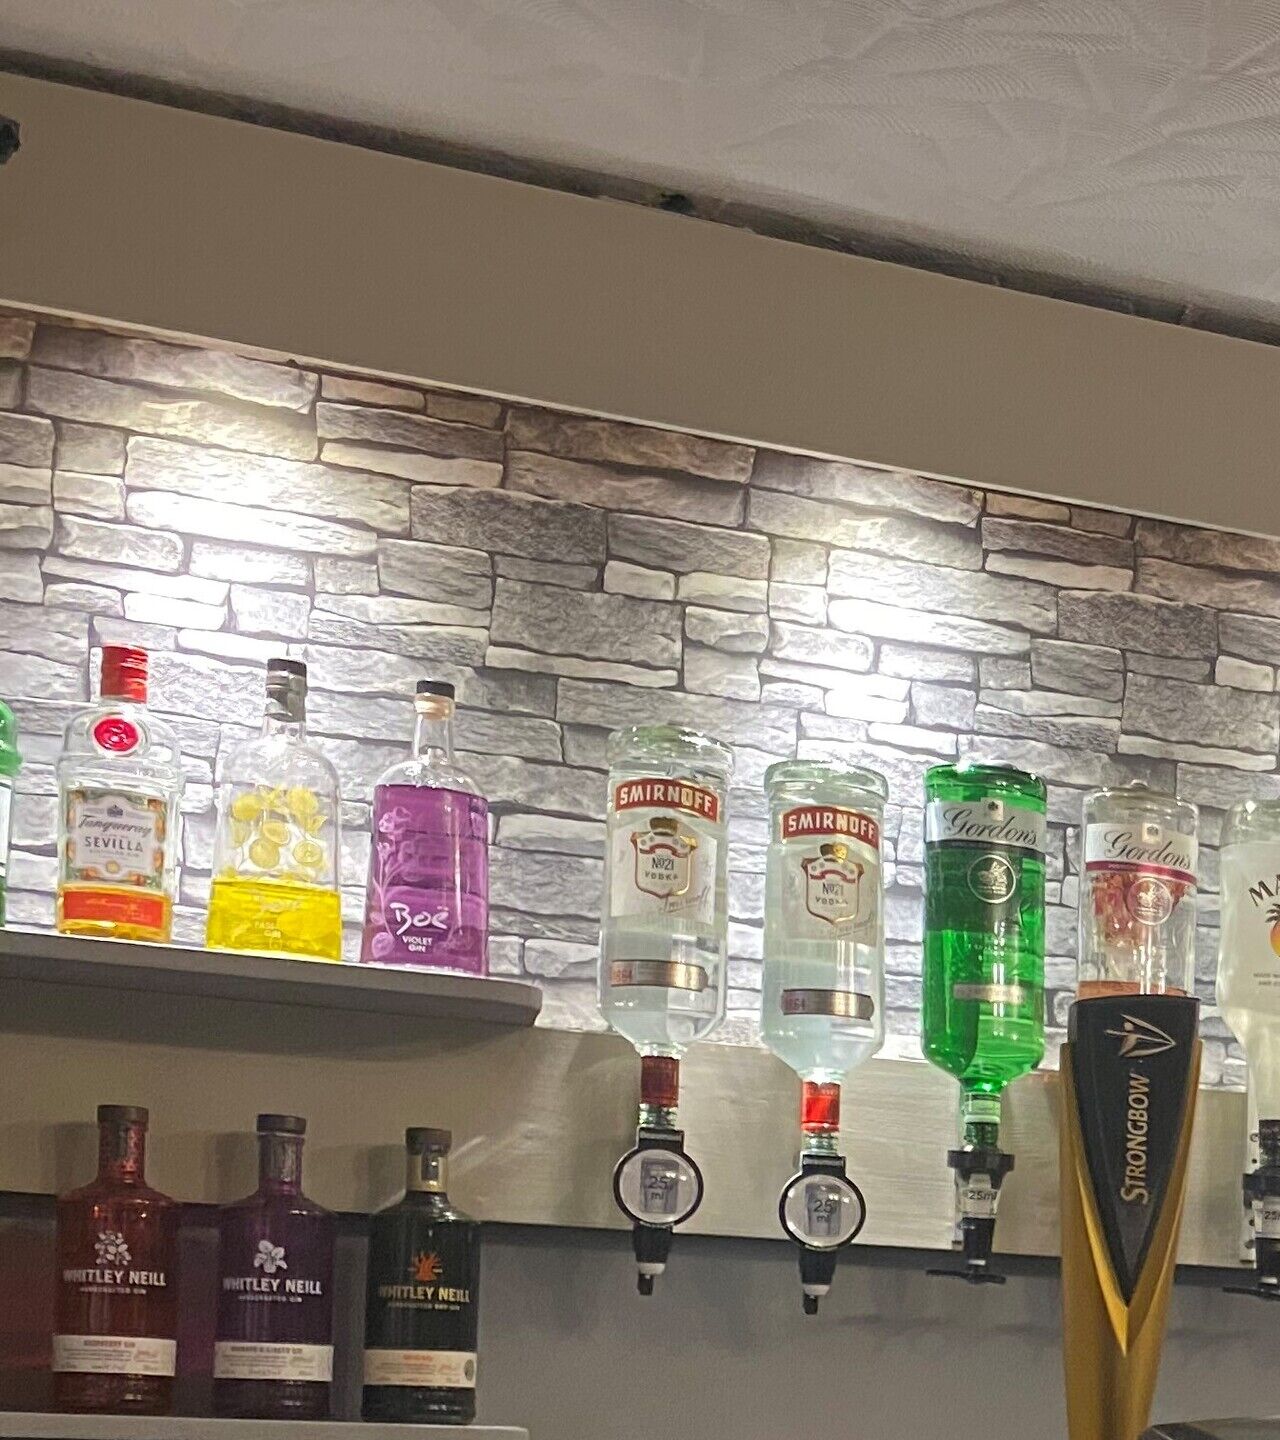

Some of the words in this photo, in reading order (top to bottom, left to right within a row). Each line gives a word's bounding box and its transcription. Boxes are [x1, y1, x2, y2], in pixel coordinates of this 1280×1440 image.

[619, 784, 713, 814] SMIRNOFF
[788, 811, 875, 840] SMIRNOFF
[84, 836, 143, 853] SEVILLA
[402, 935, 433, 946] VIOLET
[1121, 1073, 1151, 1205] STRONGBOW
[128, 1271, 167, 1287] NEILL
[285, 1279, 322, 1296] NEILL
[438, 1286, 470, 1303] NEILL
